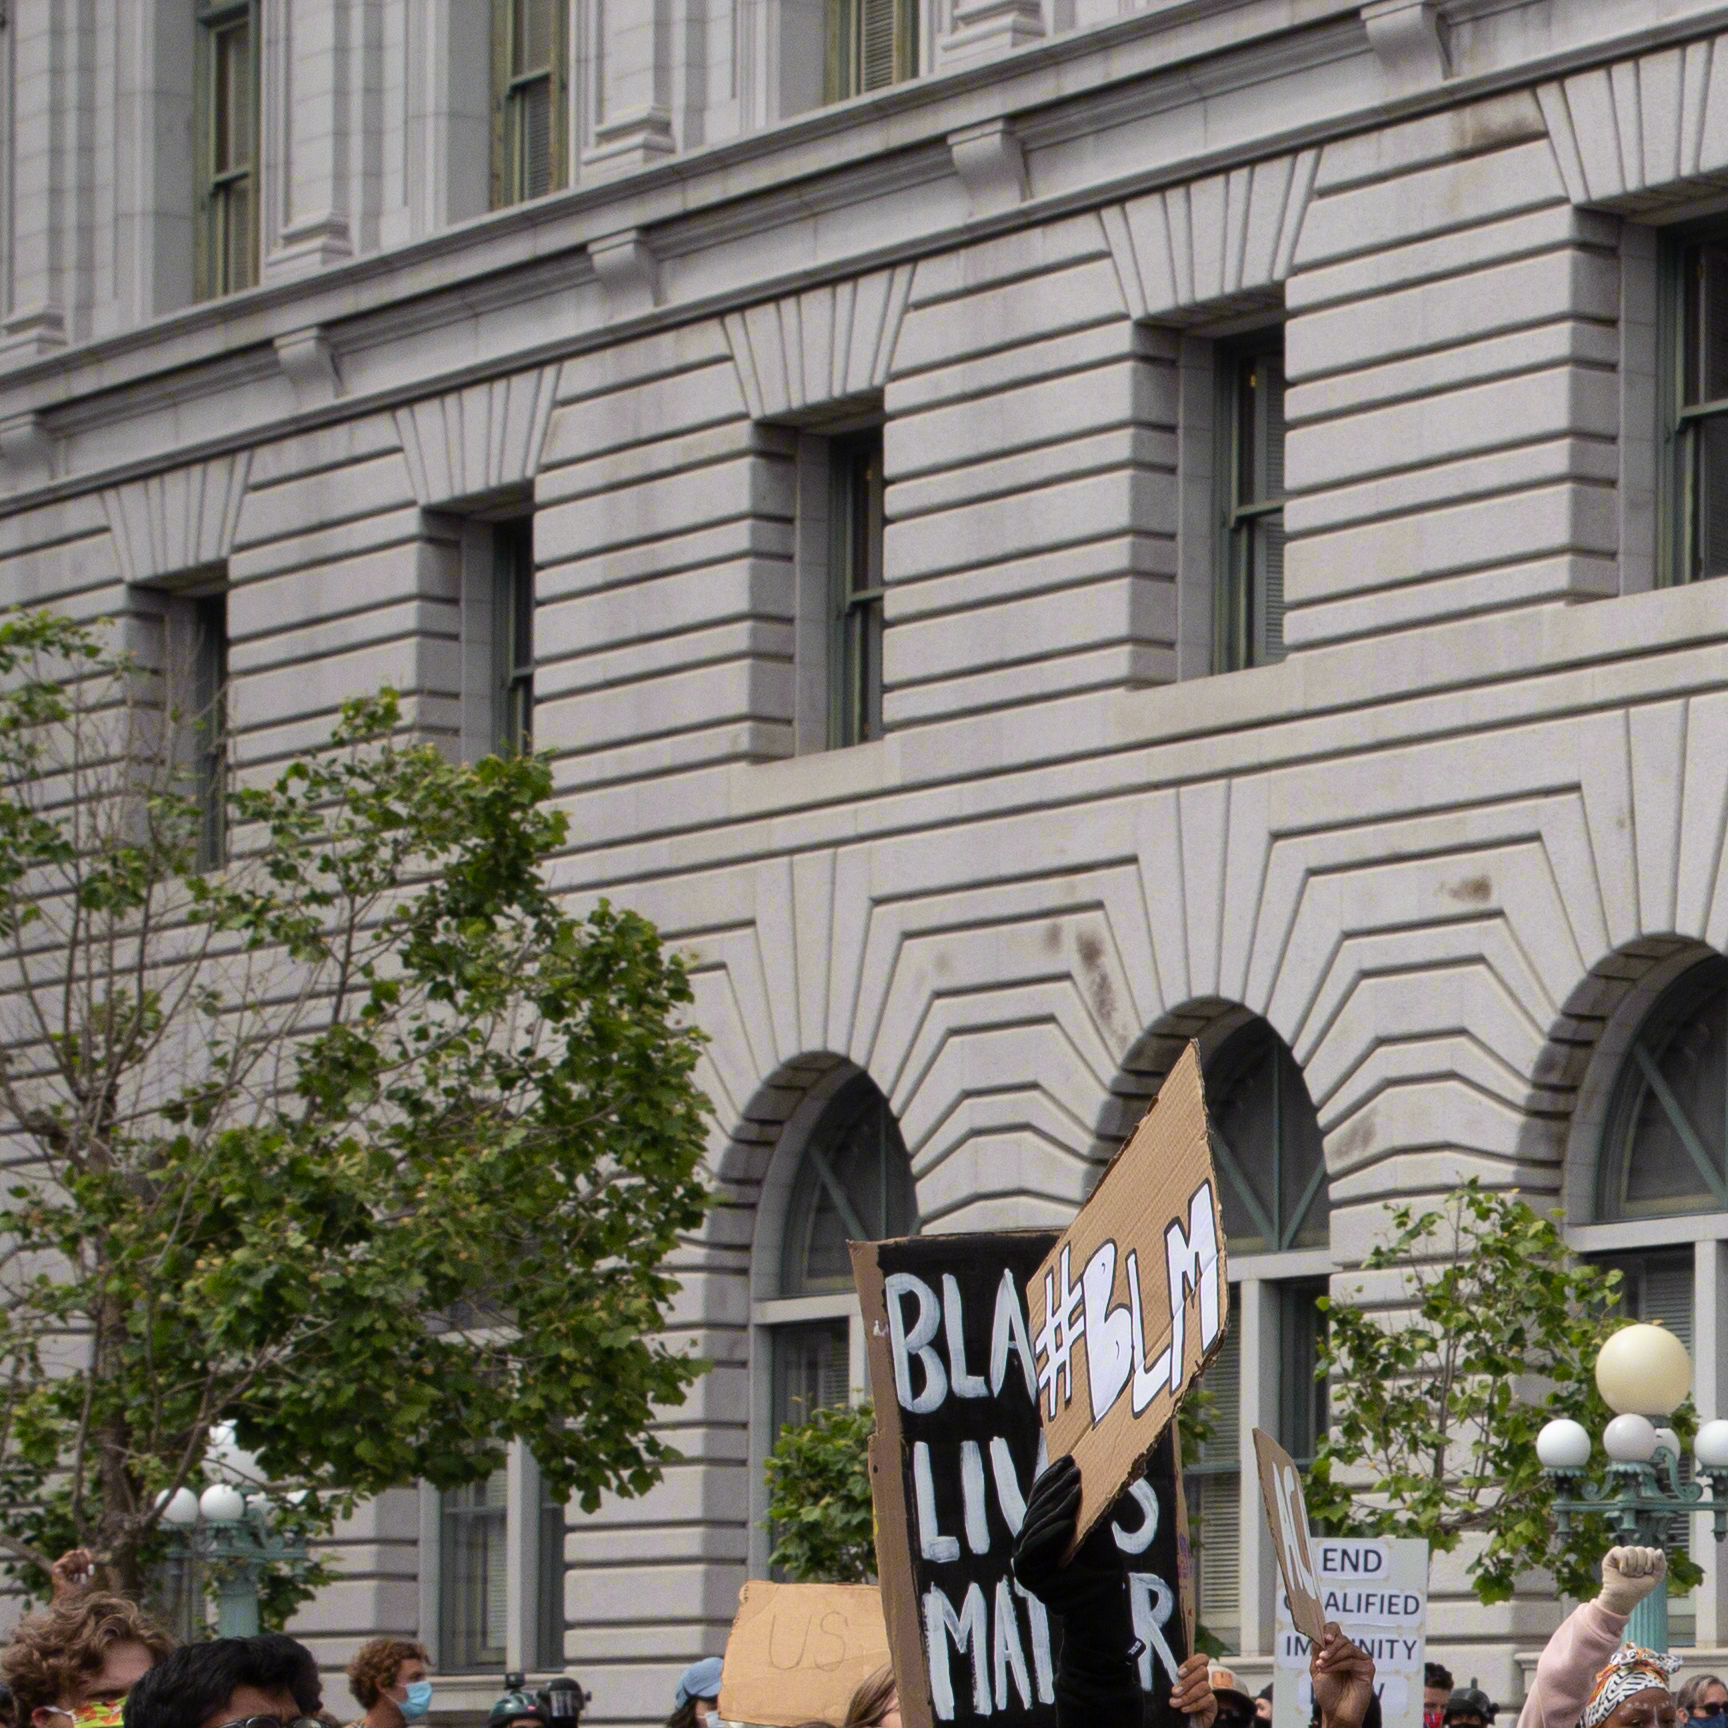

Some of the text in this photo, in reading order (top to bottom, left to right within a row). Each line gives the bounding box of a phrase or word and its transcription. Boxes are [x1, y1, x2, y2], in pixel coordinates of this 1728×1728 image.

[885, 1268, 1038, 1414] BLA
[1033, 1180, 1219, 1429] #BLM
[913, 1436, 1159, 1563] LIVS
[1284, 1592, 1419, 1615] ALIFIED
[1323, 1548, 1382, 1572] END
[768, 1611, 848, 1672] US
[922, 1572, 1180, 1721] MATR
[1286, 1636, 1417, 1660] IMNITY
